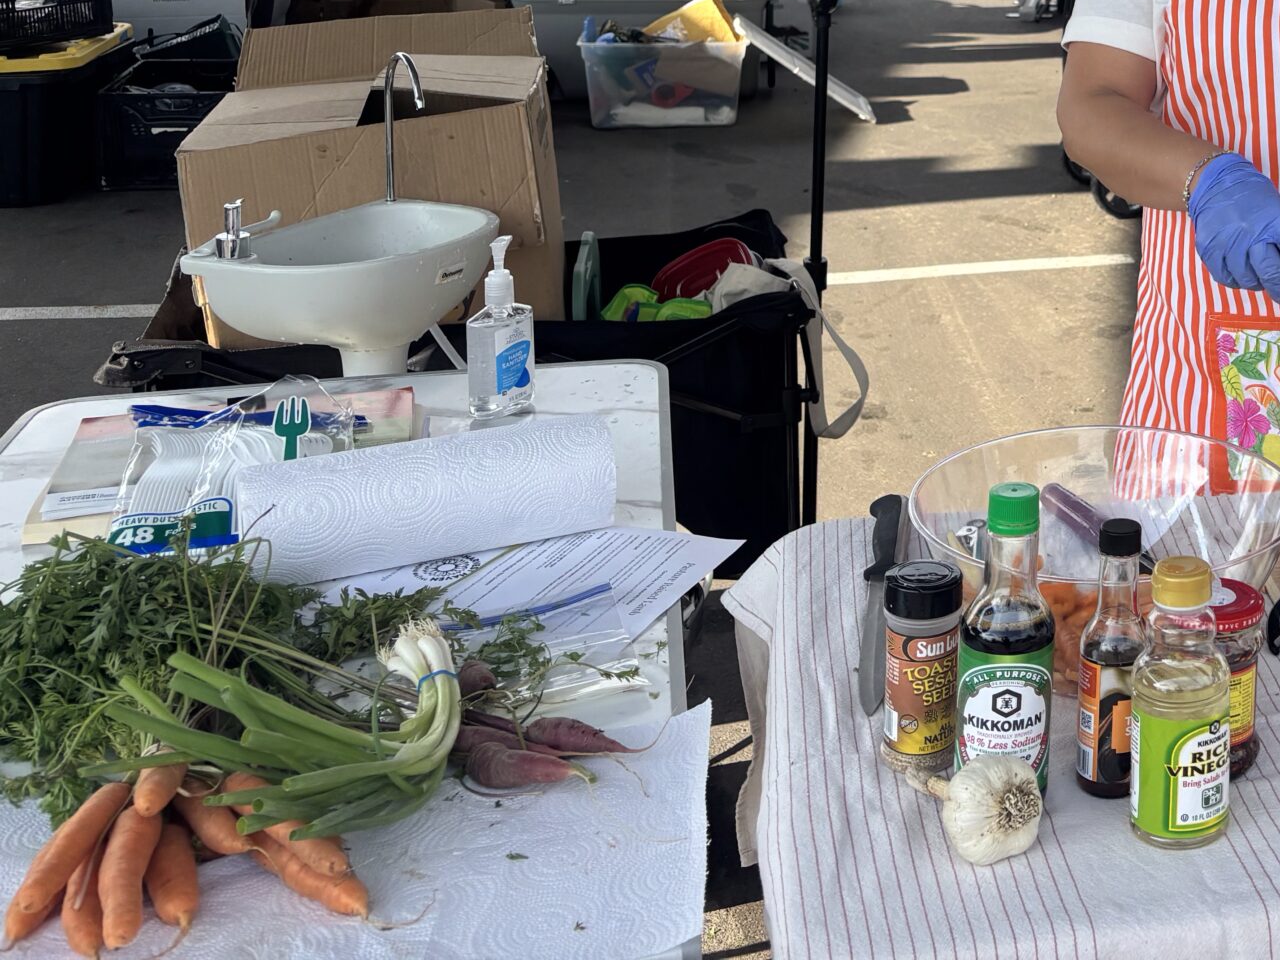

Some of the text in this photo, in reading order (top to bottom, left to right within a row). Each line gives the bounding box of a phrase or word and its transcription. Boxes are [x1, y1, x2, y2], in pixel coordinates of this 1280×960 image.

[118, 516, 150, 527] HEAVY
[191, 501, 219, 513] ASTIC
[114, 522, 197, 546] 48 Fors
[916, 641, 945, 658] Sun
[996, 670, 1041, 682] PURPOSE
[967, 711, 1042, 733] KIKKOMAN
[966, 733, 976, 745] 38
[987, 739, 1009, 750] Less
[1011, 733, 1043, 750] Sodium
[1191, 740, 1229, 764] RICE
[1182, 780, 1202, 789] Bring
